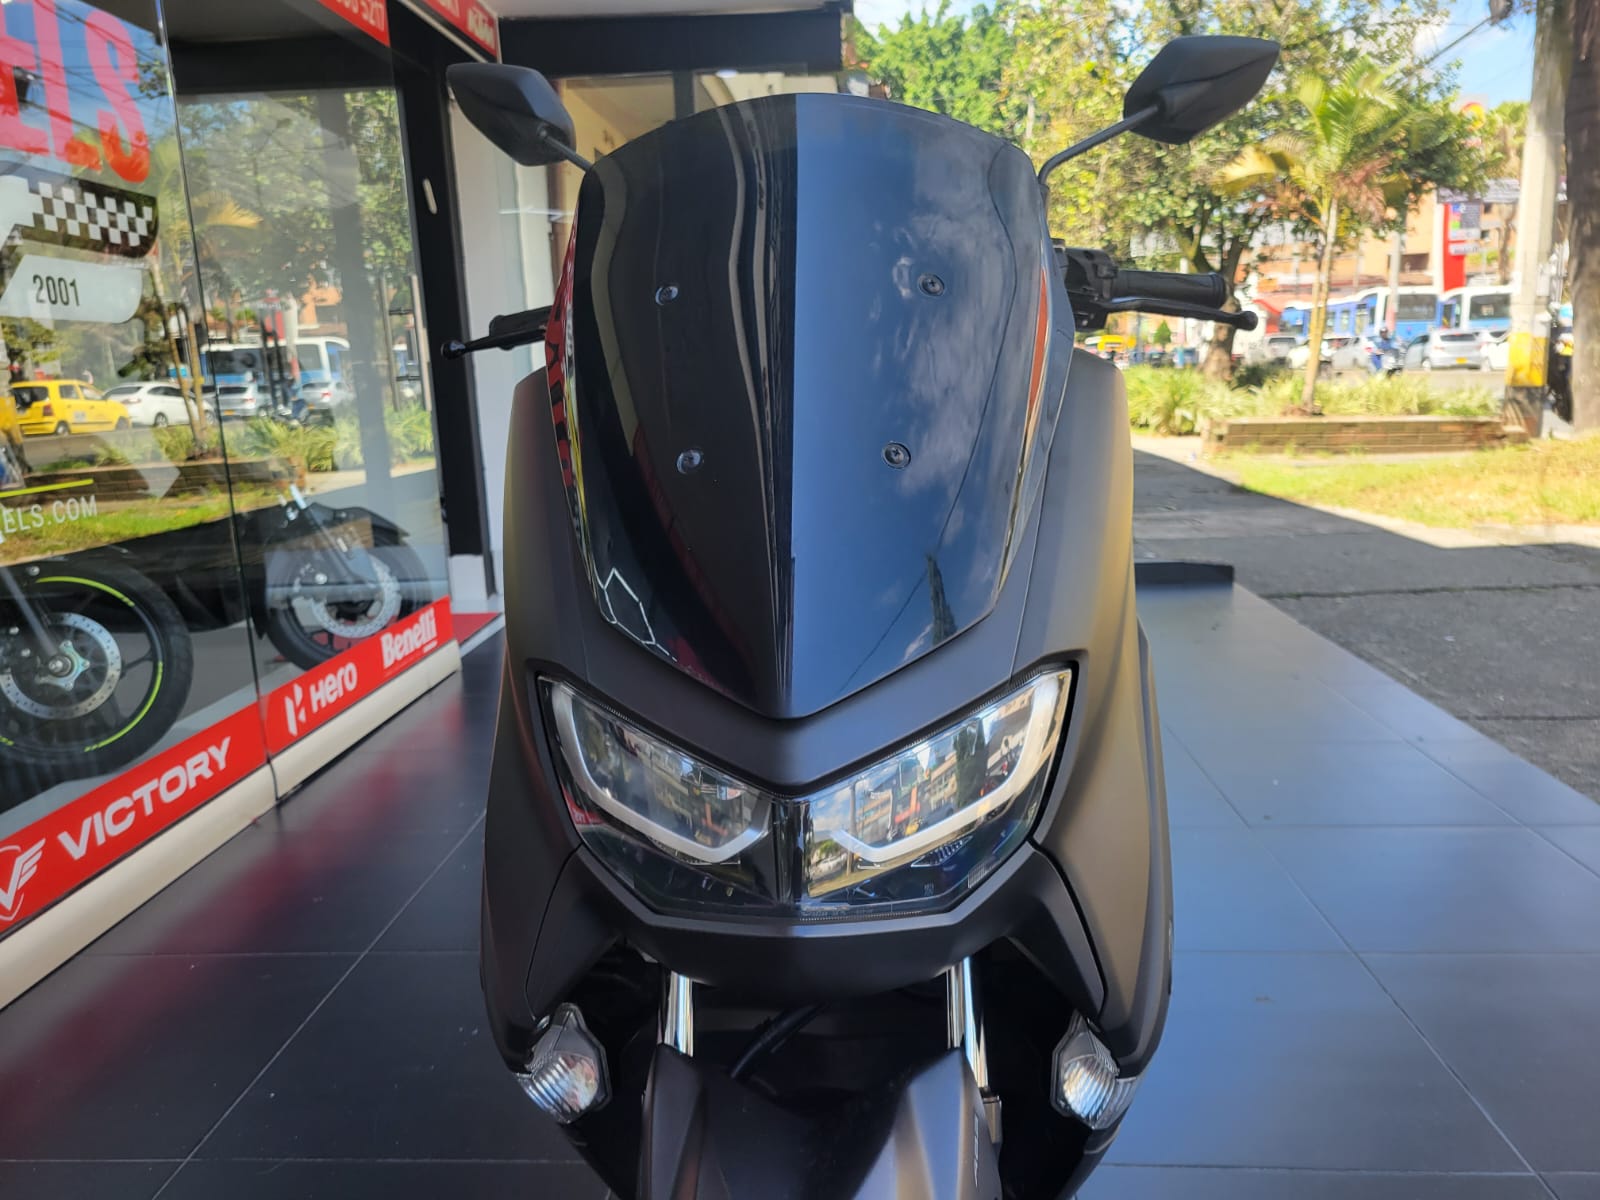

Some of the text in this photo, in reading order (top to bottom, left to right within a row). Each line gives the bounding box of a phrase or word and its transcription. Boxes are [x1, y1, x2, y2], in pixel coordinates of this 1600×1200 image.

[32, 274, 80, 307] 2001
[380, 607, 438, 669] Benelli
[57, 736, 231, 860] VICTORY
